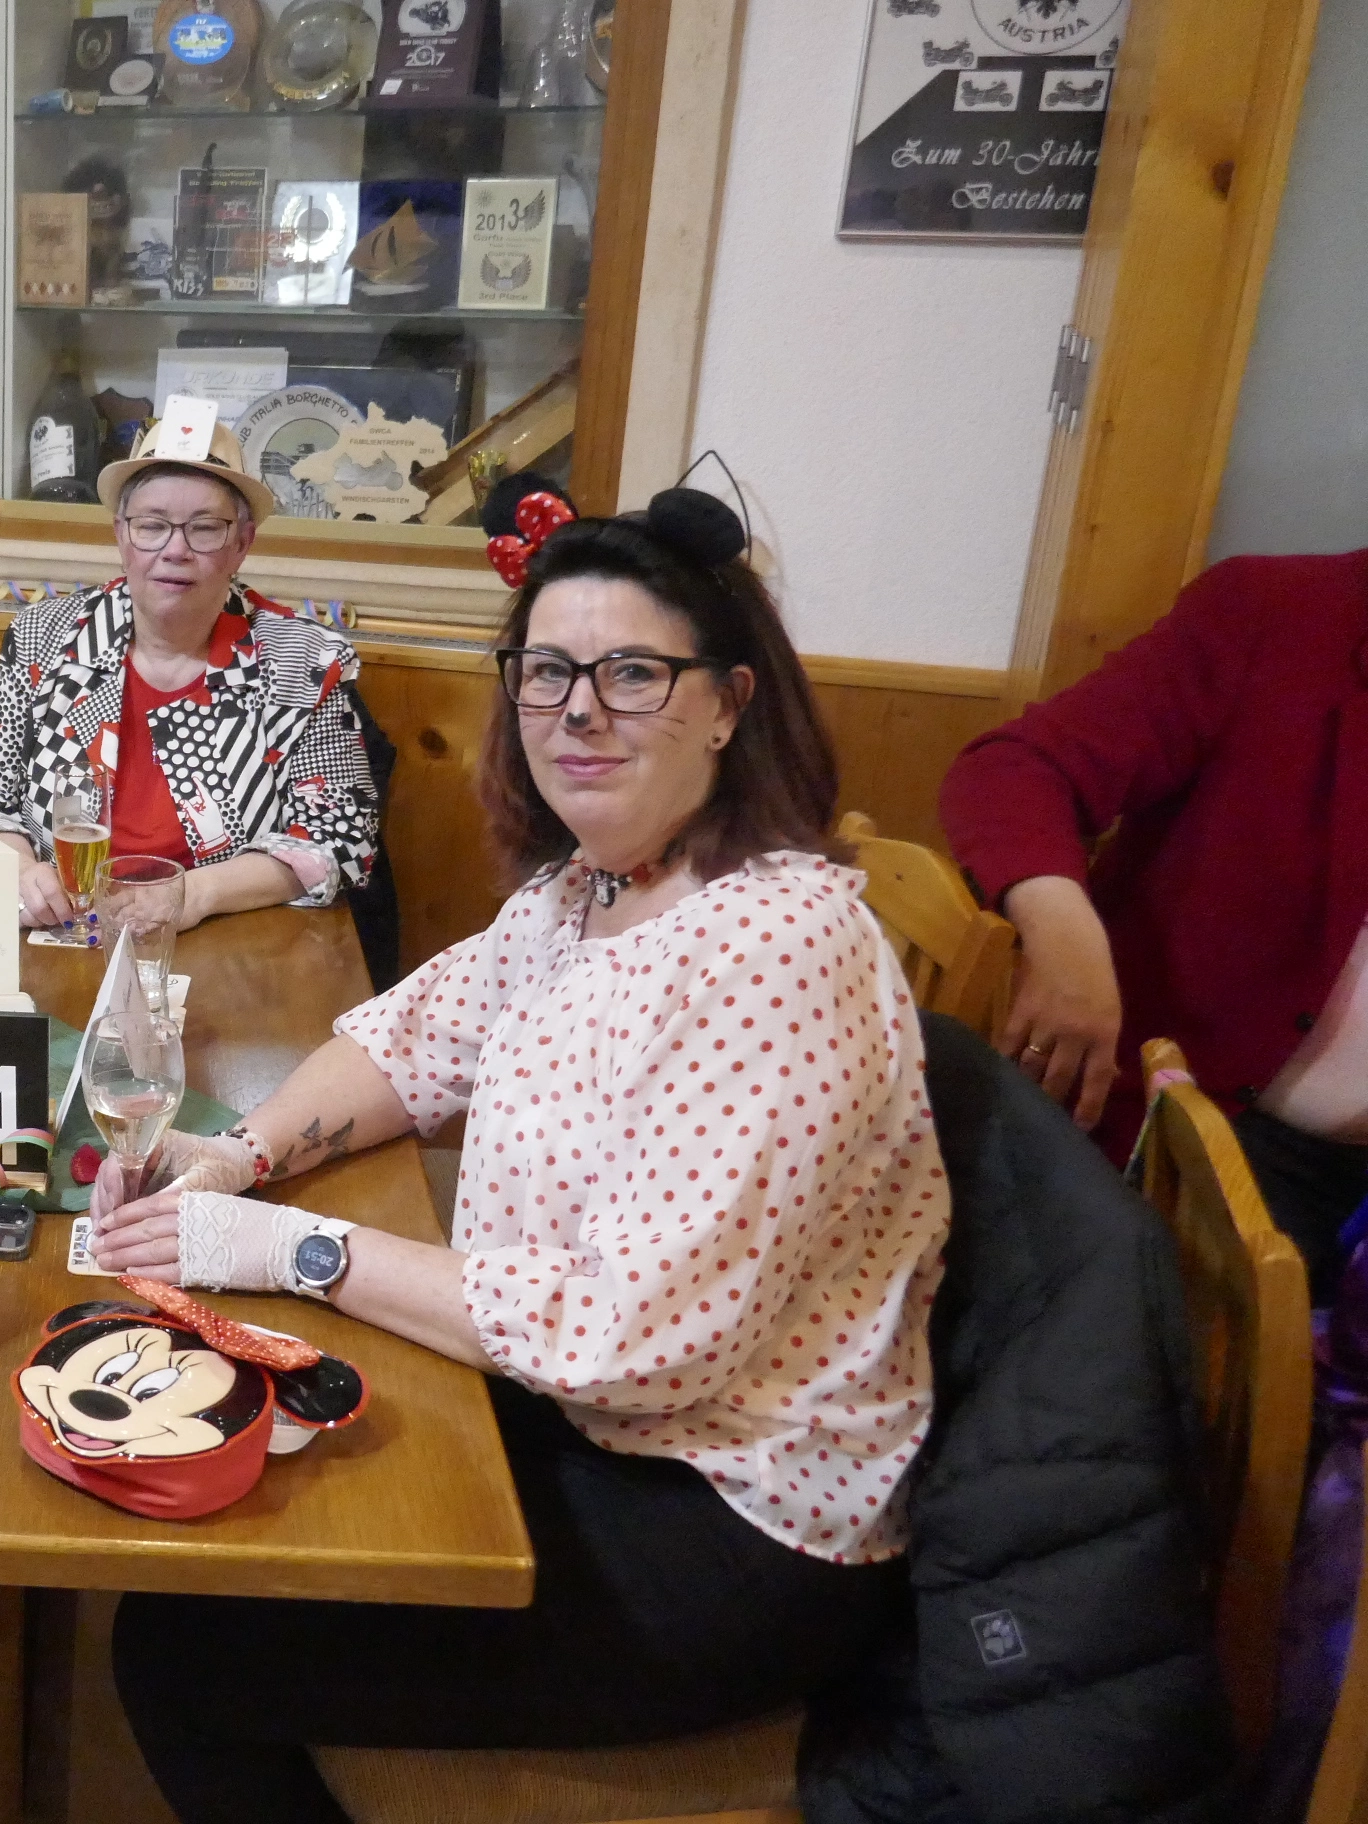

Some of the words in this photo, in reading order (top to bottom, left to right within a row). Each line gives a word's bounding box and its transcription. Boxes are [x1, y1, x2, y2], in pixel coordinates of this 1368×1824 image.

[998, 17, 1090, 44] AUSTRIA
[405, 45, 446, 67] 2017
[891, 137, 962, 168] Zum
[951, 181, 1087, 210] Bestehen
[474, 198, 520, 232] 2013
[250, 397, 282, 426] ITALIA
[285, 391, 350, 419] BORGHETTO
